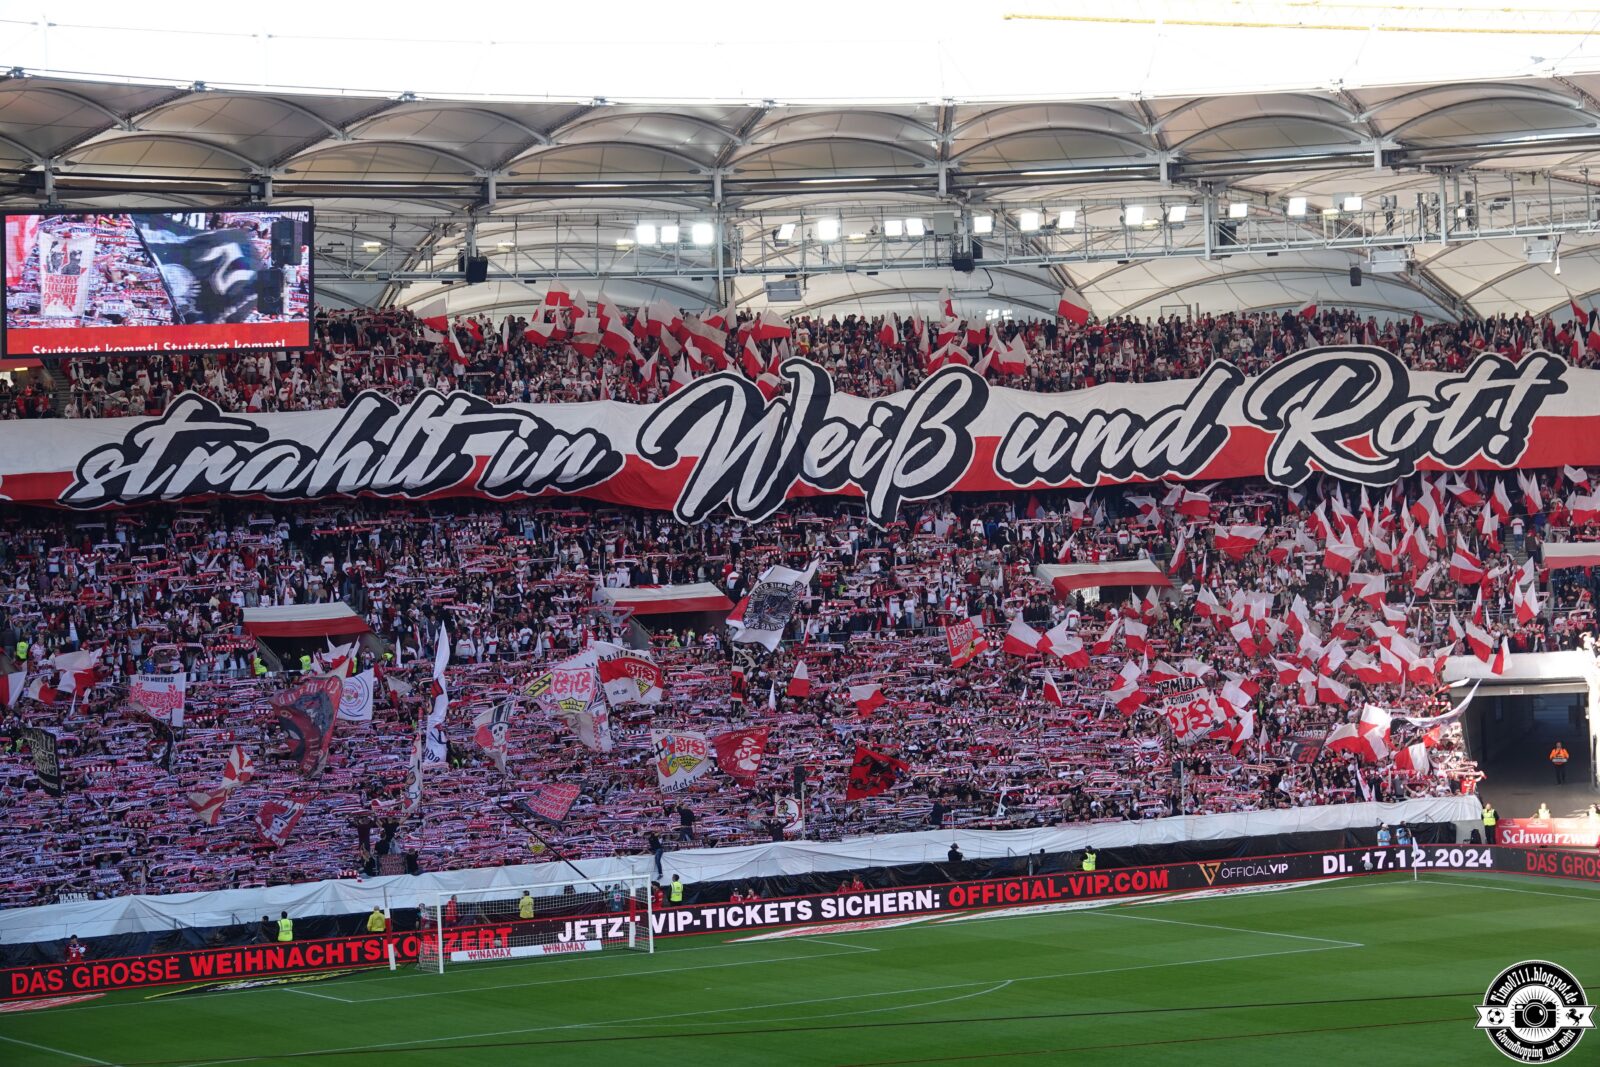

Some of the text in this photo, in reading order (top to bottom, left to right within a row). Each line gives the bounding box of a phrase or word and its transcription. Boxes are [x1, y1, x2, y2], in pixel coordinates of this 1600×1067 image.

[64, 347, 1560, 527] strahlt in Weiß und Rot!
[1322, 848, 1493, 874] DI. 17.12.2024
[1526, 851, 1600, 878] DAS GRO
[652, 900, 813, 934] VIP-TICKETS
[821, 889, 940, 919] SICHERN:
[948, 869, 1168, 907] OFFICIAL-VIP.COM
[467, 947, 512, 960] WINAMAX
[542, 941, 586, 954] WINAMAX
[11, 969, 65, 995] DAS
[72, 958, 181, 988] GROSSE
